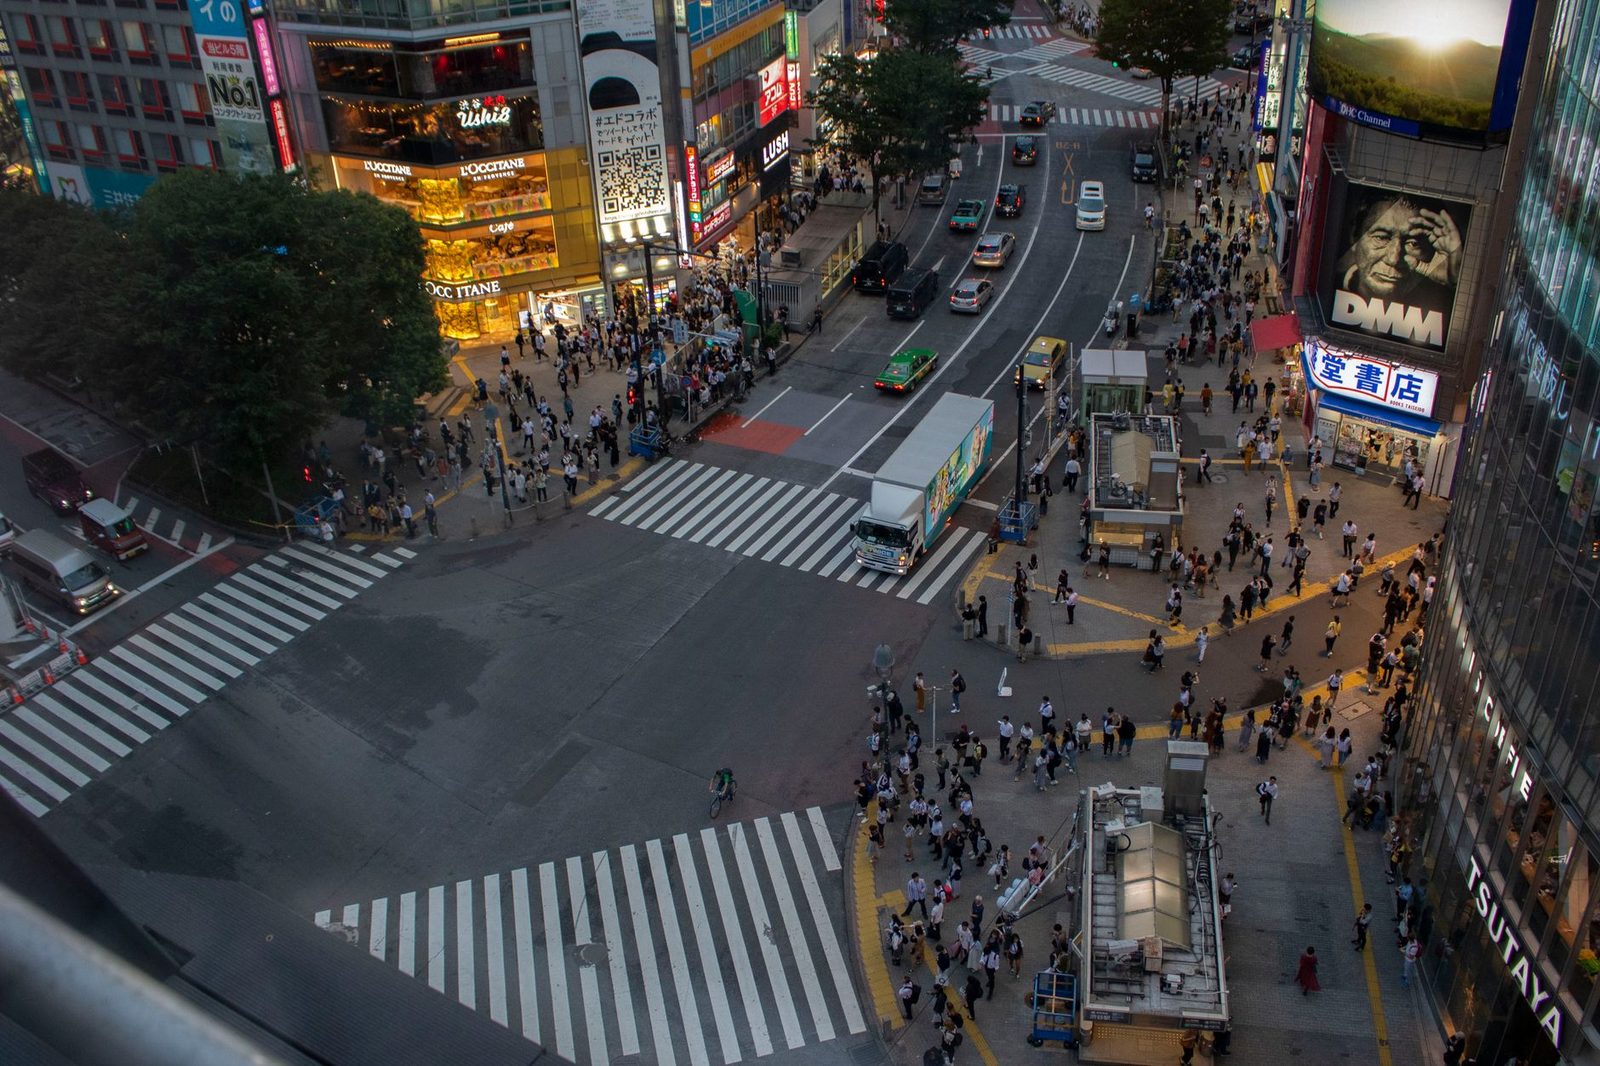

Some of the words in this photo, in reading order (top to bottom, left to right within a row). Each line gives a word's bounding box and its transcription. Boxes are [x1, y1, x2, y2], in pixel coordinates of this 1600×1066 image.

[206, 75, 260, 110] No.1
[764, 81, 784, 107] アコム
[213, 107, 262, 120] コンタクトショップ
[1357, 110, 1391, 128] Channel
[762, 129, 789, 165] LUSH
[363, 160, 412, 176] L'OCCITANE
[460, 157, 525, 176] L'OCCITANE
[103, 188, 141, 207] 三井住
[1331, 288, 1444, 347] DMM
[1467, 855, 1563, 1049] TSUTAYA
